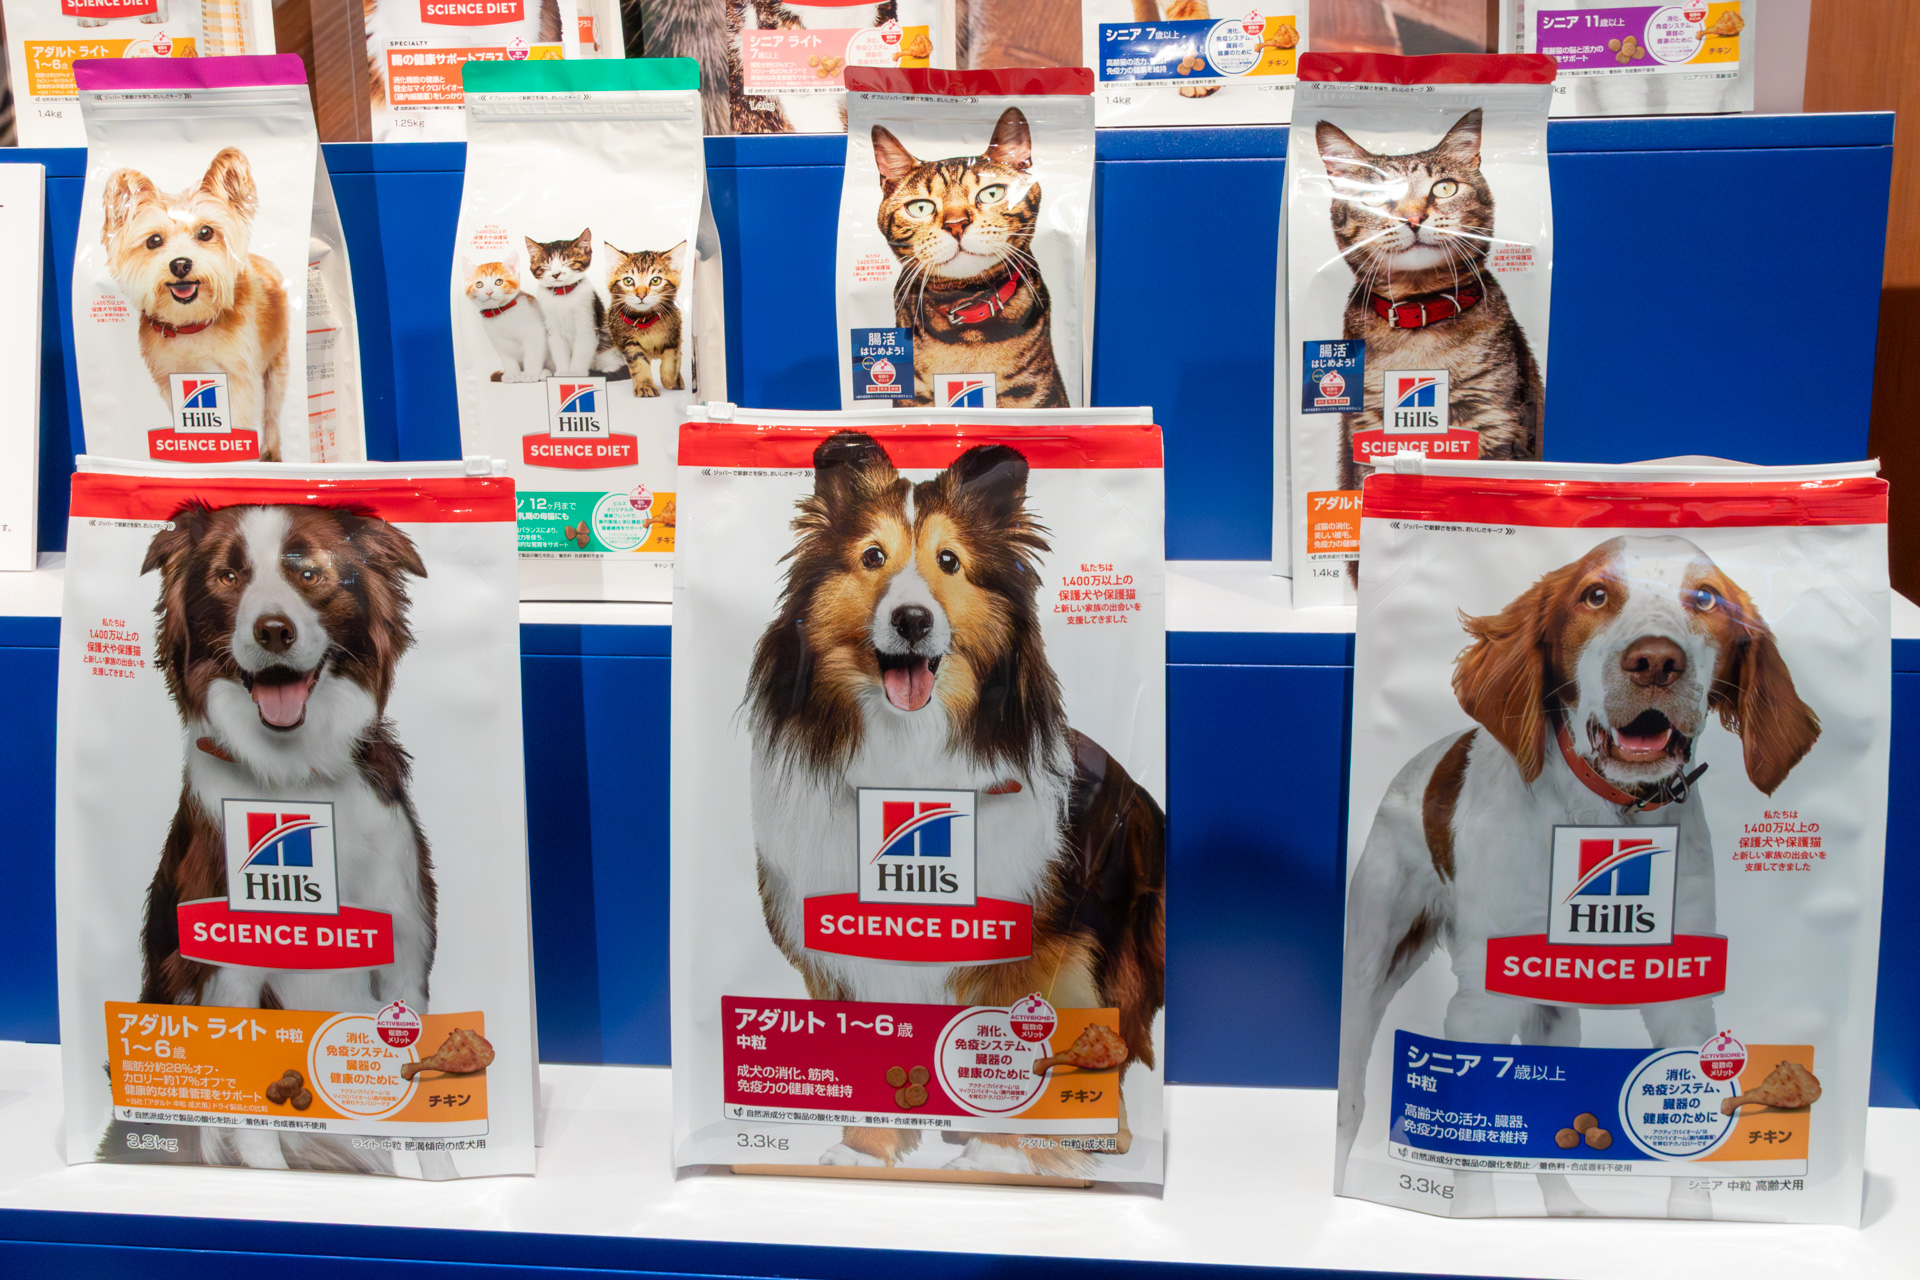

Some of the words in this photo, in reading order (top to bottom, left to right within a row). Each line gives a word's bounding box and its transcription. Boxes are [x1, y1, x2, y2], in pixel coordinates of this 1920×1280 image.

[426, 3, 484, 16] SCIENCE
[486, 2, 518, 14] DIET
[1543, 16, 1579, 30] シニア
[1585, 15, 1626, 28] 11歳以上
[750, 35, 784, 48] シニア
[788, 35, 822, 48] ライト
[1106, 28, 1142, 42] シニア
[1146, 28, 1180, 40] 7歳以上
[32, 46, 76, 58] アダルト
[79, 46, 109, 57] ライト
[1709, 47, 1732, 55] チキン
[38, 110, 63, 118] 1.4kg
[394, 119, 425, 128] 1.25kg
[182, 412, 222, 428] Hill's
[559, 416, 600, 432] Hill's
[1394, 411, 1438, 428] Hill's
[156, 438, 216, 452] SCIENCE
[220, 440, 252, 451] DIET
[530, 444, 593, 456] SCIENCE
[596, 445, 630, 456] DIET
[1361, 441, 1429, 453] SCIENCE
[1434, 441, 1470, 452] DIET
[1314, 496, 1362, 511] アダルト
[1080, 564, 1114, 572] 私たちは
[1313, 568, 1339, 578] 1.4kg
[1062, 574, 1133, 586] 1,400万以上の
[1059, 588, 1136, 601] 保護犬や保護猫
[1054, 603, 1141, 613] と新しい家族の出会いを
[102, 618, 125, 627] 私たちは
[1066, 614, 1128, 625] 支援してきました
[89, 629, 139, 642] 1,400万以上の
[87, 642, 141, 656] 保護犬や保護猫
[1764, 810, 1798, 819] 私たちは
[1744, 822, 1820, 834] 1,400万以上の
[1739, 836, 1822, 848] 保護犬や保護猫
[1732, 850, 1827, 860] と新しい家族の出会いを
[1744, 862, 1811, 872] 支援してきました
[877, 864, 958, 894] Hill's
[245, 872, 322, 902] Hill's
[1568, 903, 1656, 933] Hill's
[820, 914, 942, 938] SCIENCE
[952, 919, 1016, 940] DIET
[194, 922, 308, 946] SCIENCE
[317, 927, 378, 948] DIET
[1502, 956, 1635, 980] SCIENCE
[1645, 956, 1712, 980] DIET
[118, 1013, 199, 1038] アダルト
[207, 1018, 267, 1042] ライト
[276, 1028, 304, 1043] 中粒
[734, 1008, 826, 1034] アダルト
[346, 1032, 374, 1044] 消化、
[977, 1025, 1008, 1038] 消化、
[736, 1034, 766, 1050] 中粒
[955, 1038, 1033, 1053] 免疫システム、
[326, 1045, 398, 1058] 免疫システム、
[1408, 1045, 1482, 1076] シニア
[1492, 1056, 1566, 1082] 7歳以上
[330, 1072, 398, 1085] 健康のために
[737, 1064, 840, 1082] 成犬の消化、筋肉、
[958, 1068, 1030, 1080] 健康のために
[1666, 1068, 1696, 1081] 消化、
[737, 1079, 853, 1098] 免疫力の健康を維持
[1406, 1072, 1438, 1092] 中粒
[124, 1085, 262, 1102] 健康的な体重管理をサポート
[1060, 1090, 1103, 1103] チキン
[1642, 1083, 1720, 1096] 免疫システム、
[429, 1094, 471, 1108] チキン
[1404, 1103, 1528, 1129] 高齢犬の活力、臓器、
[1643, 1112, 1718, 1124] 健康のために
[1404, 1119, 1528, 1145] 免疫力の健康を維持
[1749, 1130, 1792, 1144] チキン
[127, 1133, 178, 1152] 3.3kg
[352, 1138, 380, 1149] ライト
[383, 1140, 402, 1150] 中粒
[405, 1139, 486, 1152] 肥満傾向の成犬用
[736, 1132, 790, 1150] 3.3kg
[1018, 1138, 1058, 1148] アダルト
[1060, 1138, 1082, 1149] 中粒
[1084, 1138, 1116, 1149] 成犬用
[1400, 1174, 1455, 1200] 3.3kg
[1688, 1180, 1723, 1191] シニア
[1728, 1181, 1752, 1191] 中粒
[1756, 1180, 1804, 1191] 高齢犬用
